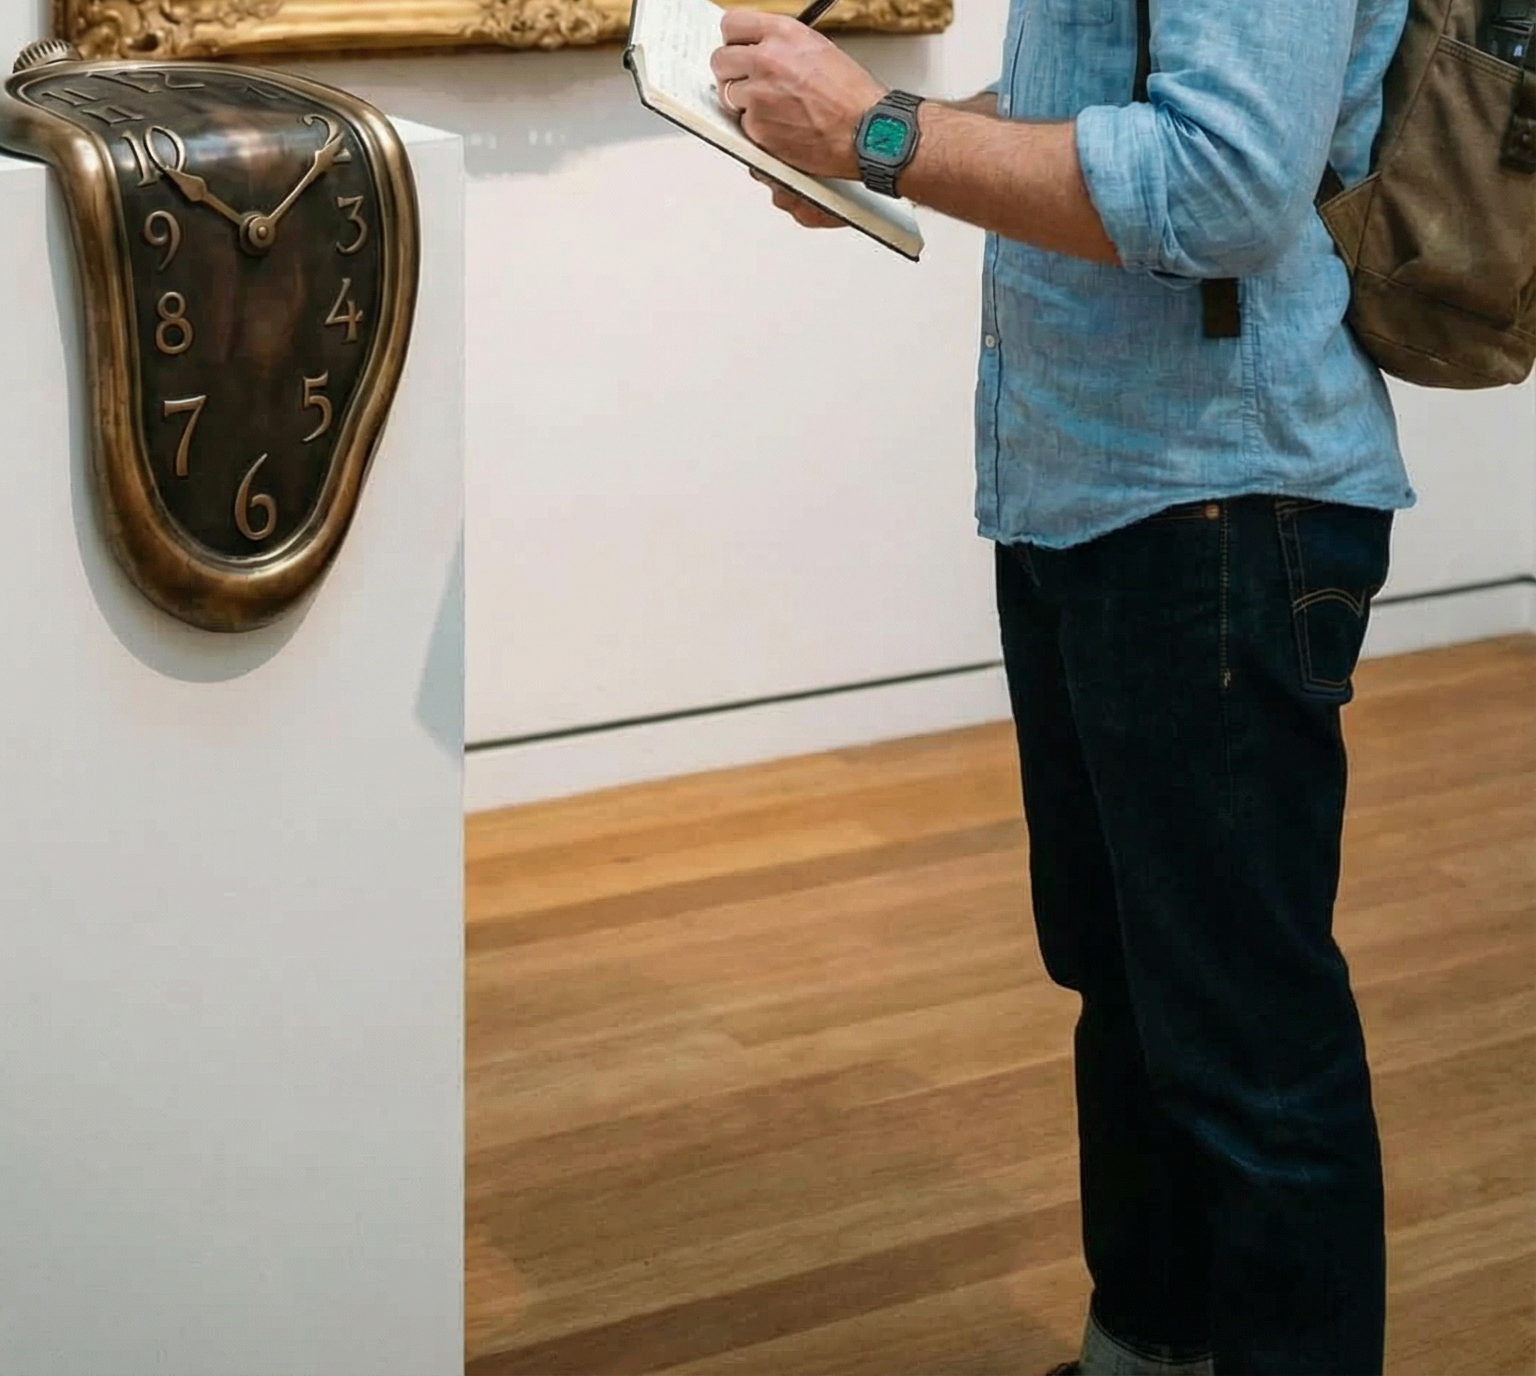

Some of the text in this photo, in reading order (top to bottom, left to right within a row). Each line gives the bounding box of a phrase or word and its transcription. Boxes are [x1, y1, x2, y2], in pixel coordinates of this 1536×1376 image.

[121, 125, 187, 187] 10
[144, 210, 181, 272] 9
[336, 195, 368, 254] 3
[155, 291, 194, 354] 8
[325, 277, 363, 344] 4
[164, 394, 207, 477] 7
[302, 371, 332, 442] 5
[235, 453, 277, 541] 6
